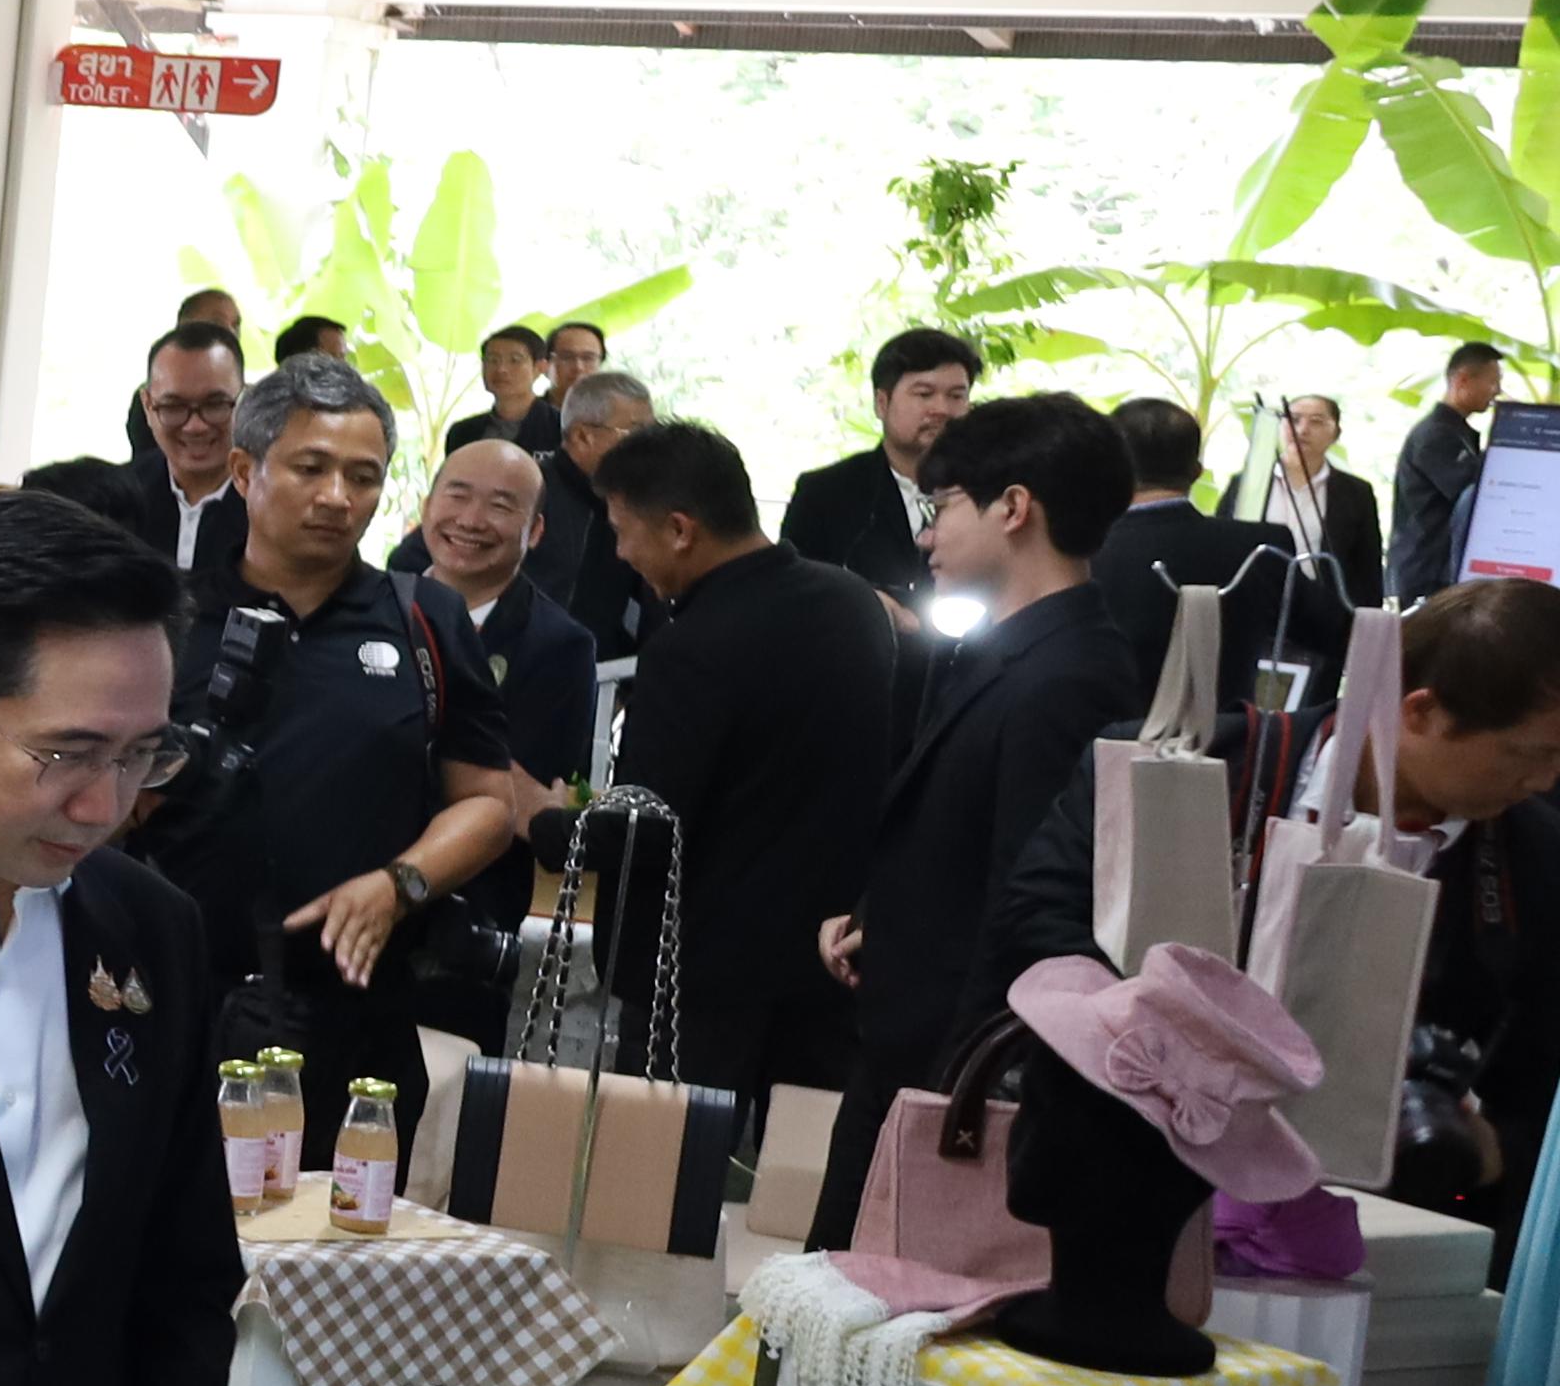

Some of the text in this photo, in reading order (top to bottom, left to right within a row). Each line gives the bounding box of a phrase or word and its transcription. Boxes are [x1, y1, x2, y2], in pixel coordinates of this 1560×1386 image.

[77, 51, 134, 86] สุขา
[68, 82, 132, 104] TOILET
[415, 646, 438, 691] EOS
